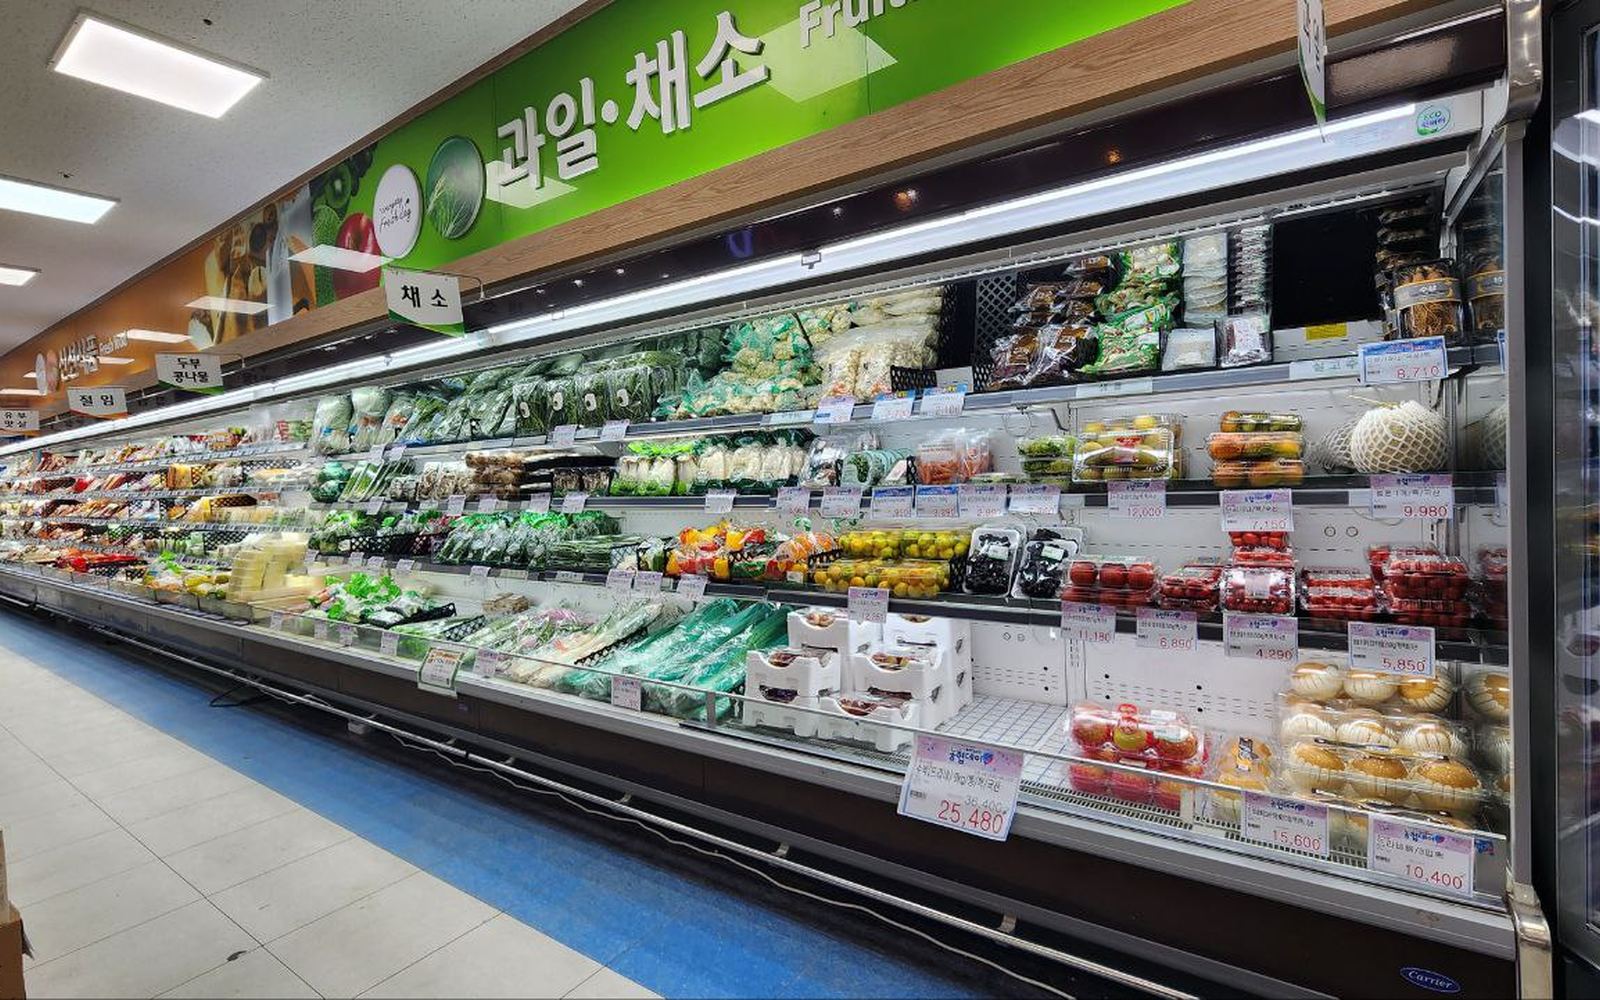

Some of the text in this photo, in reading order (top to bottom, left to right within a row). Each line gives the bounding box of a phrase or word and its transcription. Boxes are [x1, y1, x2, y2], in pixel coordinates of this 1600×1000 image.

[800, 0, 907, 48] Fru
[497, 11, 769, 189] 과일·채소
[401, 284, 448, 308] 채소
[177, 357, 200, 369] 두부
[1404, 505, 1448, 517] 9,980
[938, 800, 1003, 834] 25,480
[1272, 830, 1321, 851] 15,600
[1405, 864, 1463, 890] 10,400
[1408, 970, 1453, 989] Carrier
